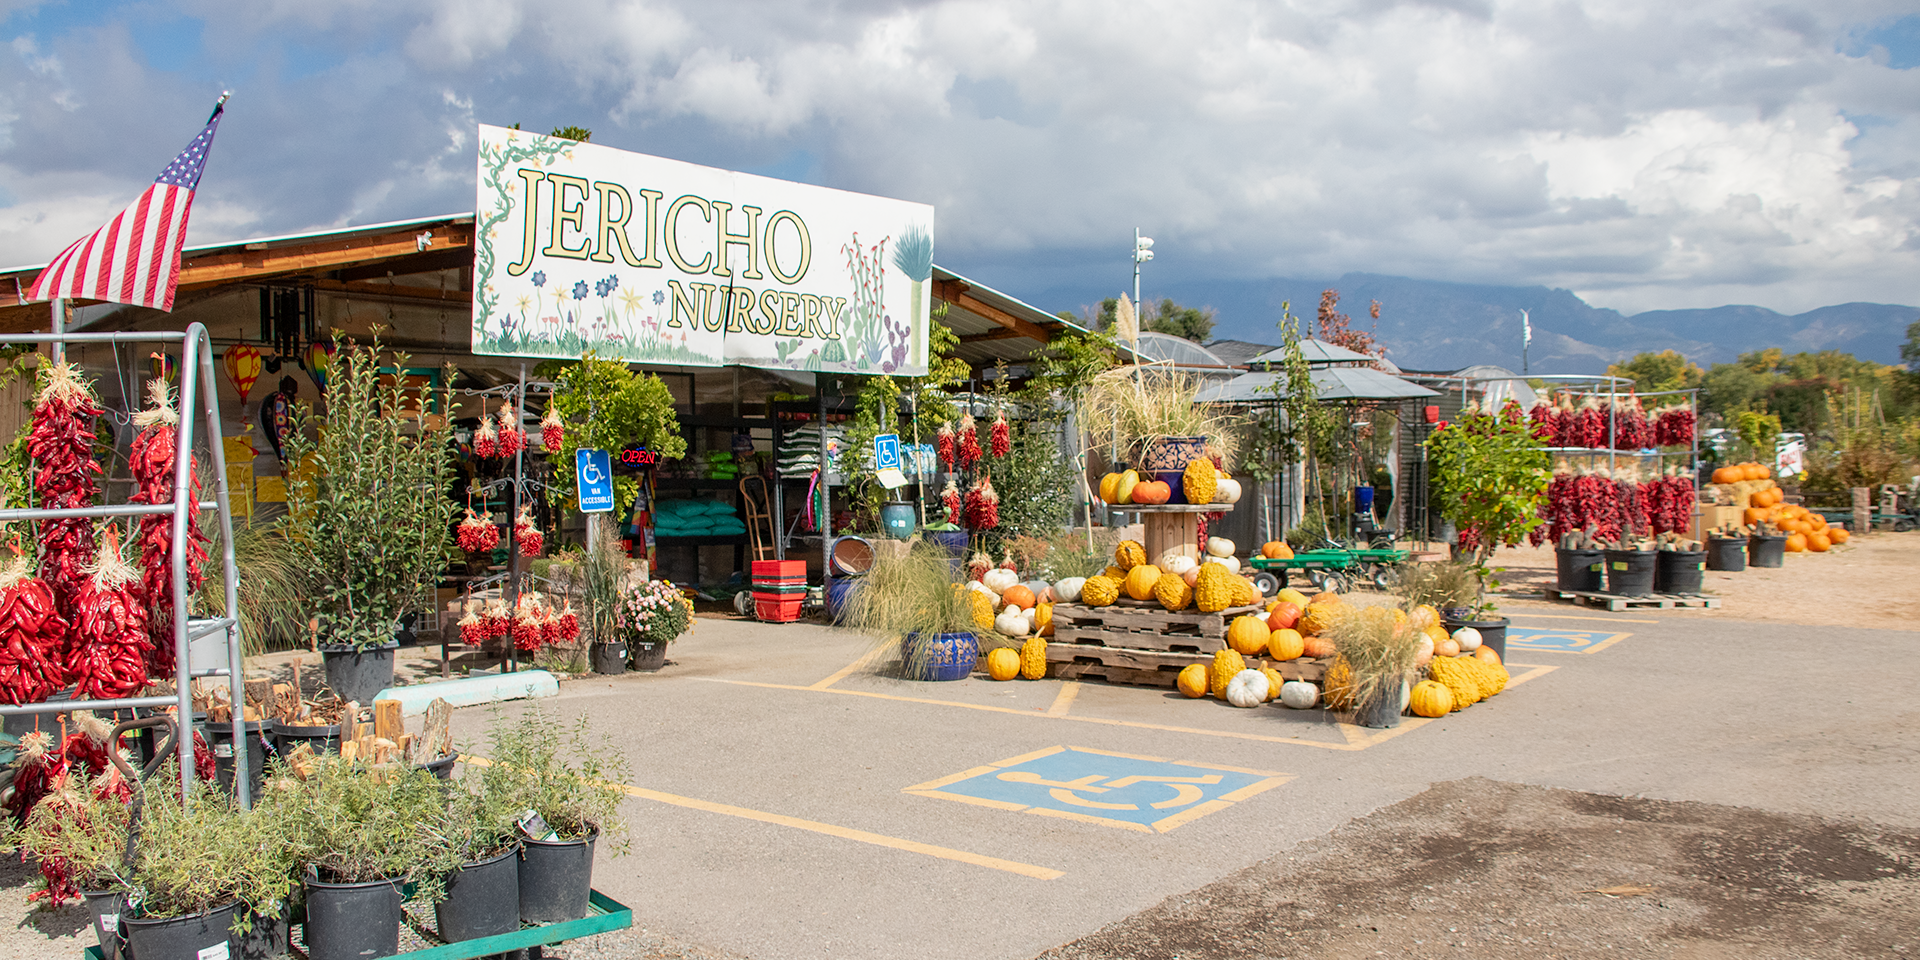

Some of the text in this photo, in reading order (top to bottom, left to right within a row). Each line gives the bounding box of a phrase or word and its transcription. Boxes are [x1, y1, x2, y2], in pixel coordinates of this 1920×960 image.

[507, 168, 811, 285] JERICHO
[667, 279, 847, 340] NURSERY
[622, 449, 655, 464] OPEN
[582, 496, 611, 504] ACCESSIBLE
